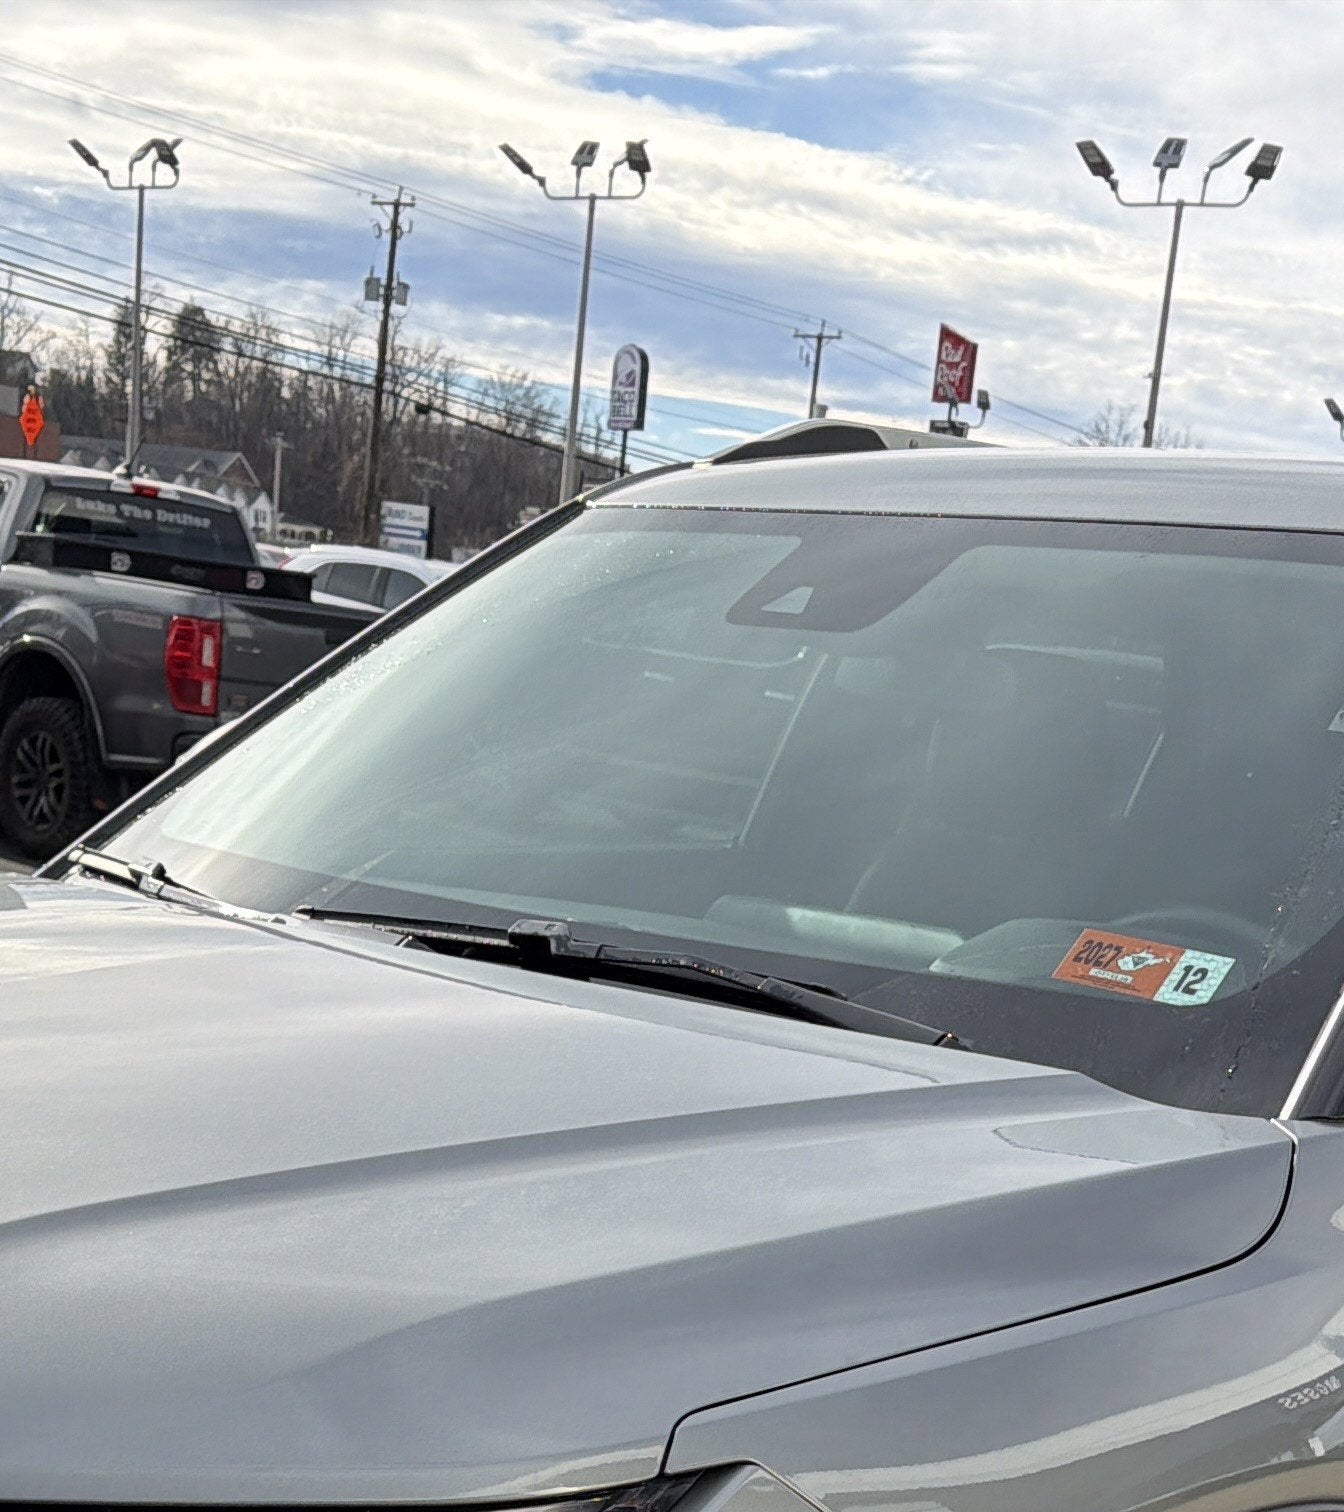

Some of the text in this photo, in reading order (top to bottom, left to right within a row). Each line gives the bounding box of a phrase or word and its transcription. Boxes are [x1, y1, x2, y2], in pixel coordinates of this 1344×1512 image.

[610, 389, 635, 404] TACO
[610, 403, 634, 418] BELL
[119, 502, 153, 520] The
[1072, 938, 1125, 969] 2027
[1172, 964, 1209, 996] 12
